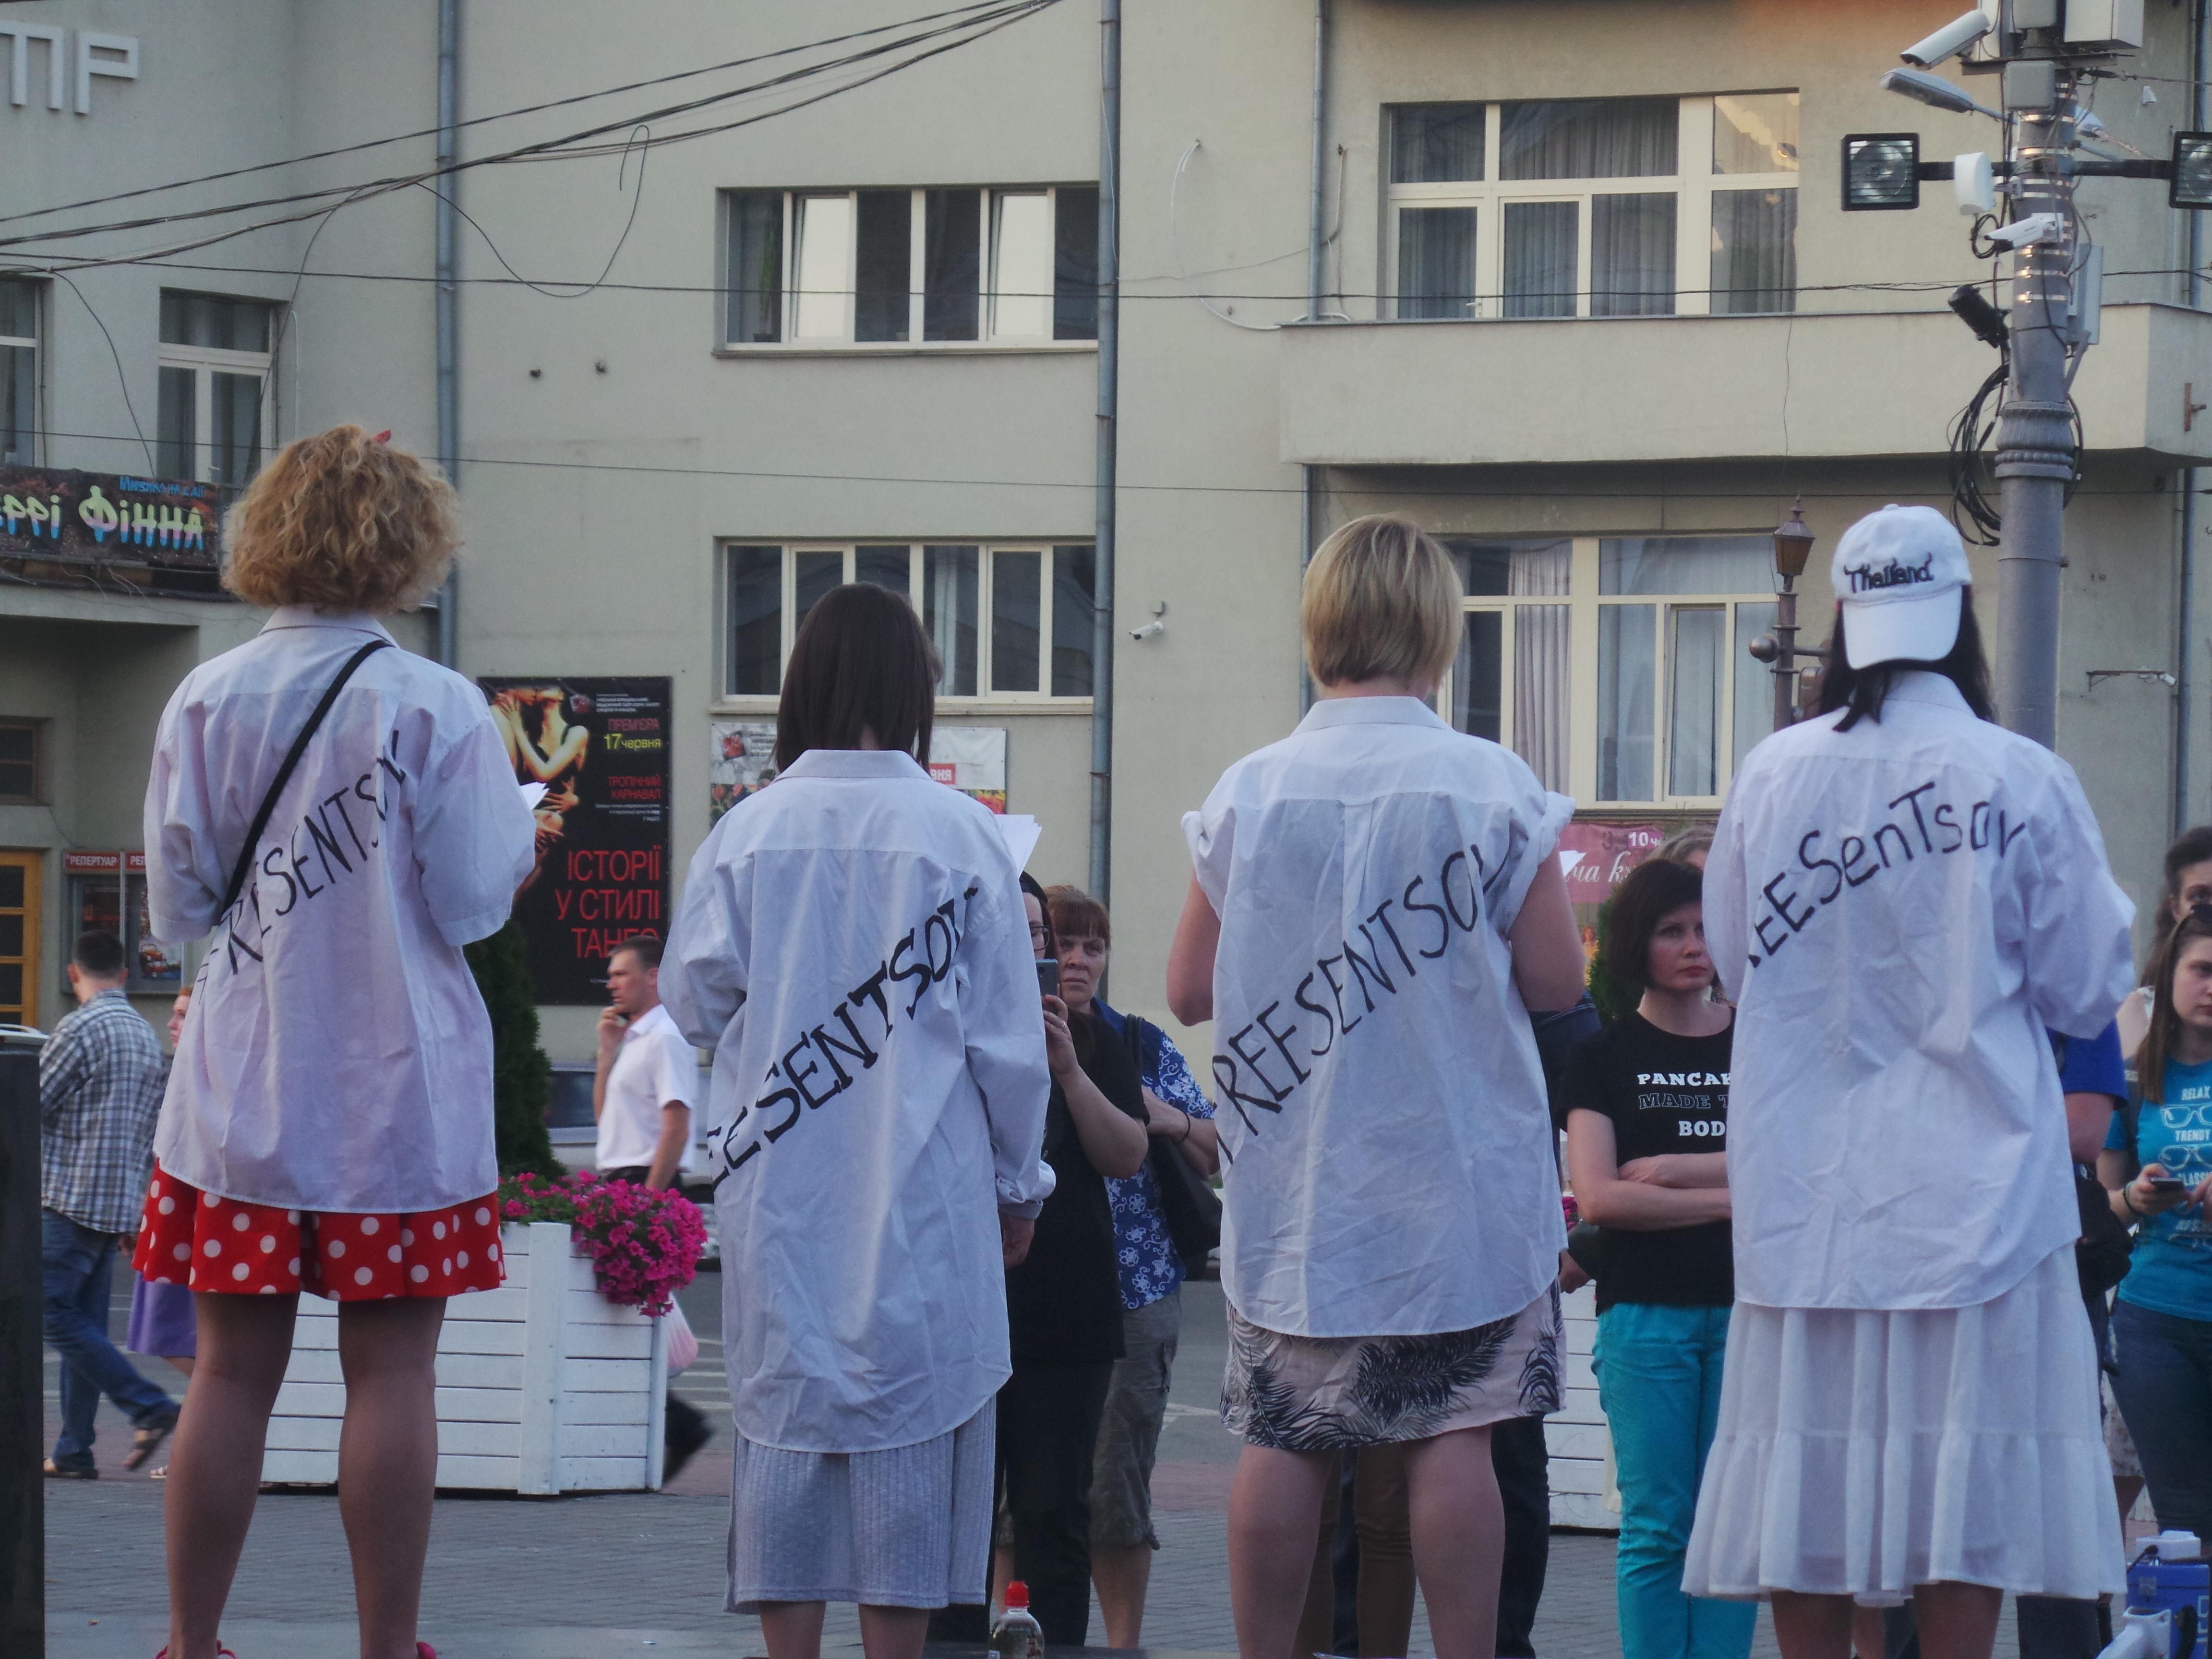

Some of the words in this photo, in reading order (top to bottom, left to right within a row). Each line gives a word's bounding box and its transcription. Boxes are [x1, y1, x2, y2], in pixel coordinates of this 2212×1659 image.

[604, 733, 621, 750] 17
[621, 738, 661, 751] червня
[1628, 831, 1649, 846] 10
[70, 855, 117, 866] РЕПЕРТУАР
[568, 845, 661, 881] ІСТОРІЇ
[554, 890, 573, 920] У
[579, 889, 661, 920] СТИЛІ
[1639, 1093, 1711, 1109] MADE
[2182, 1086, 2210, 1101] RELAX
[2176, 1129, 2211, 1142] TRENDY
